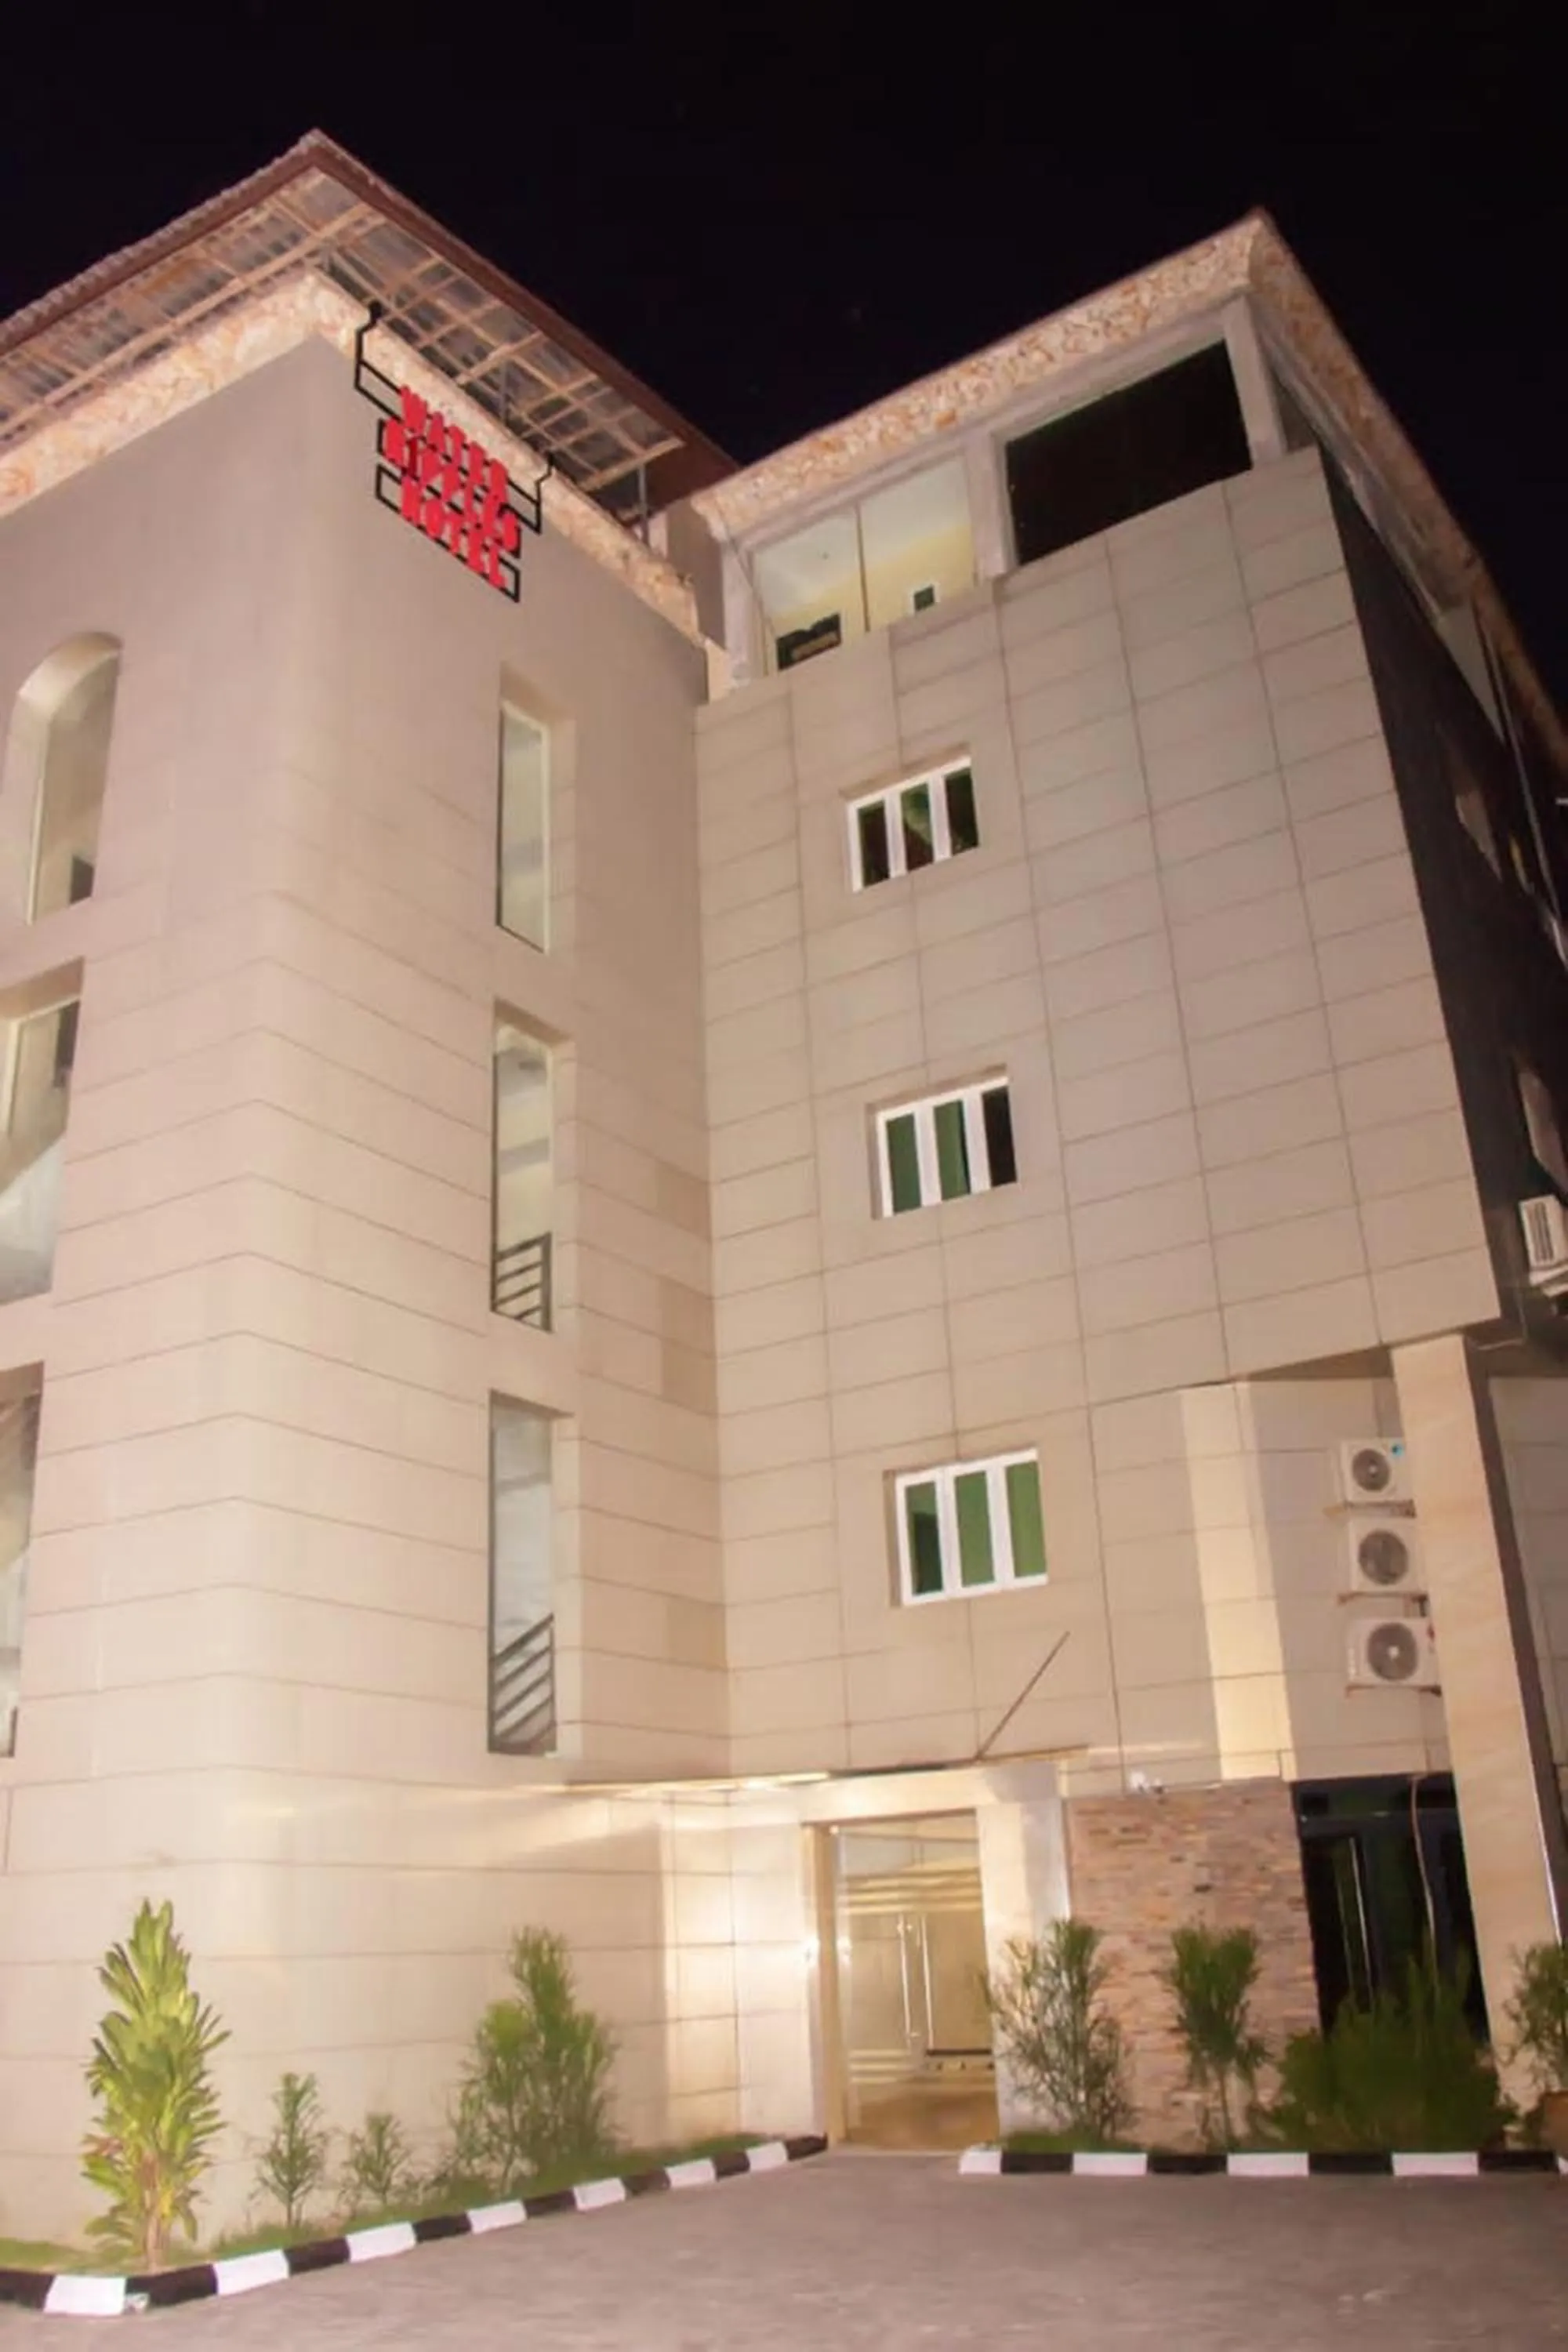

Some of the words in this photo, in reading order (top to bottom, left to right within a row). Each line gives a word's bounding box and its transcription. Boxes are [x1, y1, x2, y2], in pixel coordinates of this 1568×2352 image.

[383, 416, 520, 552] RIPPLES
[400, 385, 509, 502] WATER
[401, 475, 508, 589] HOTEL
